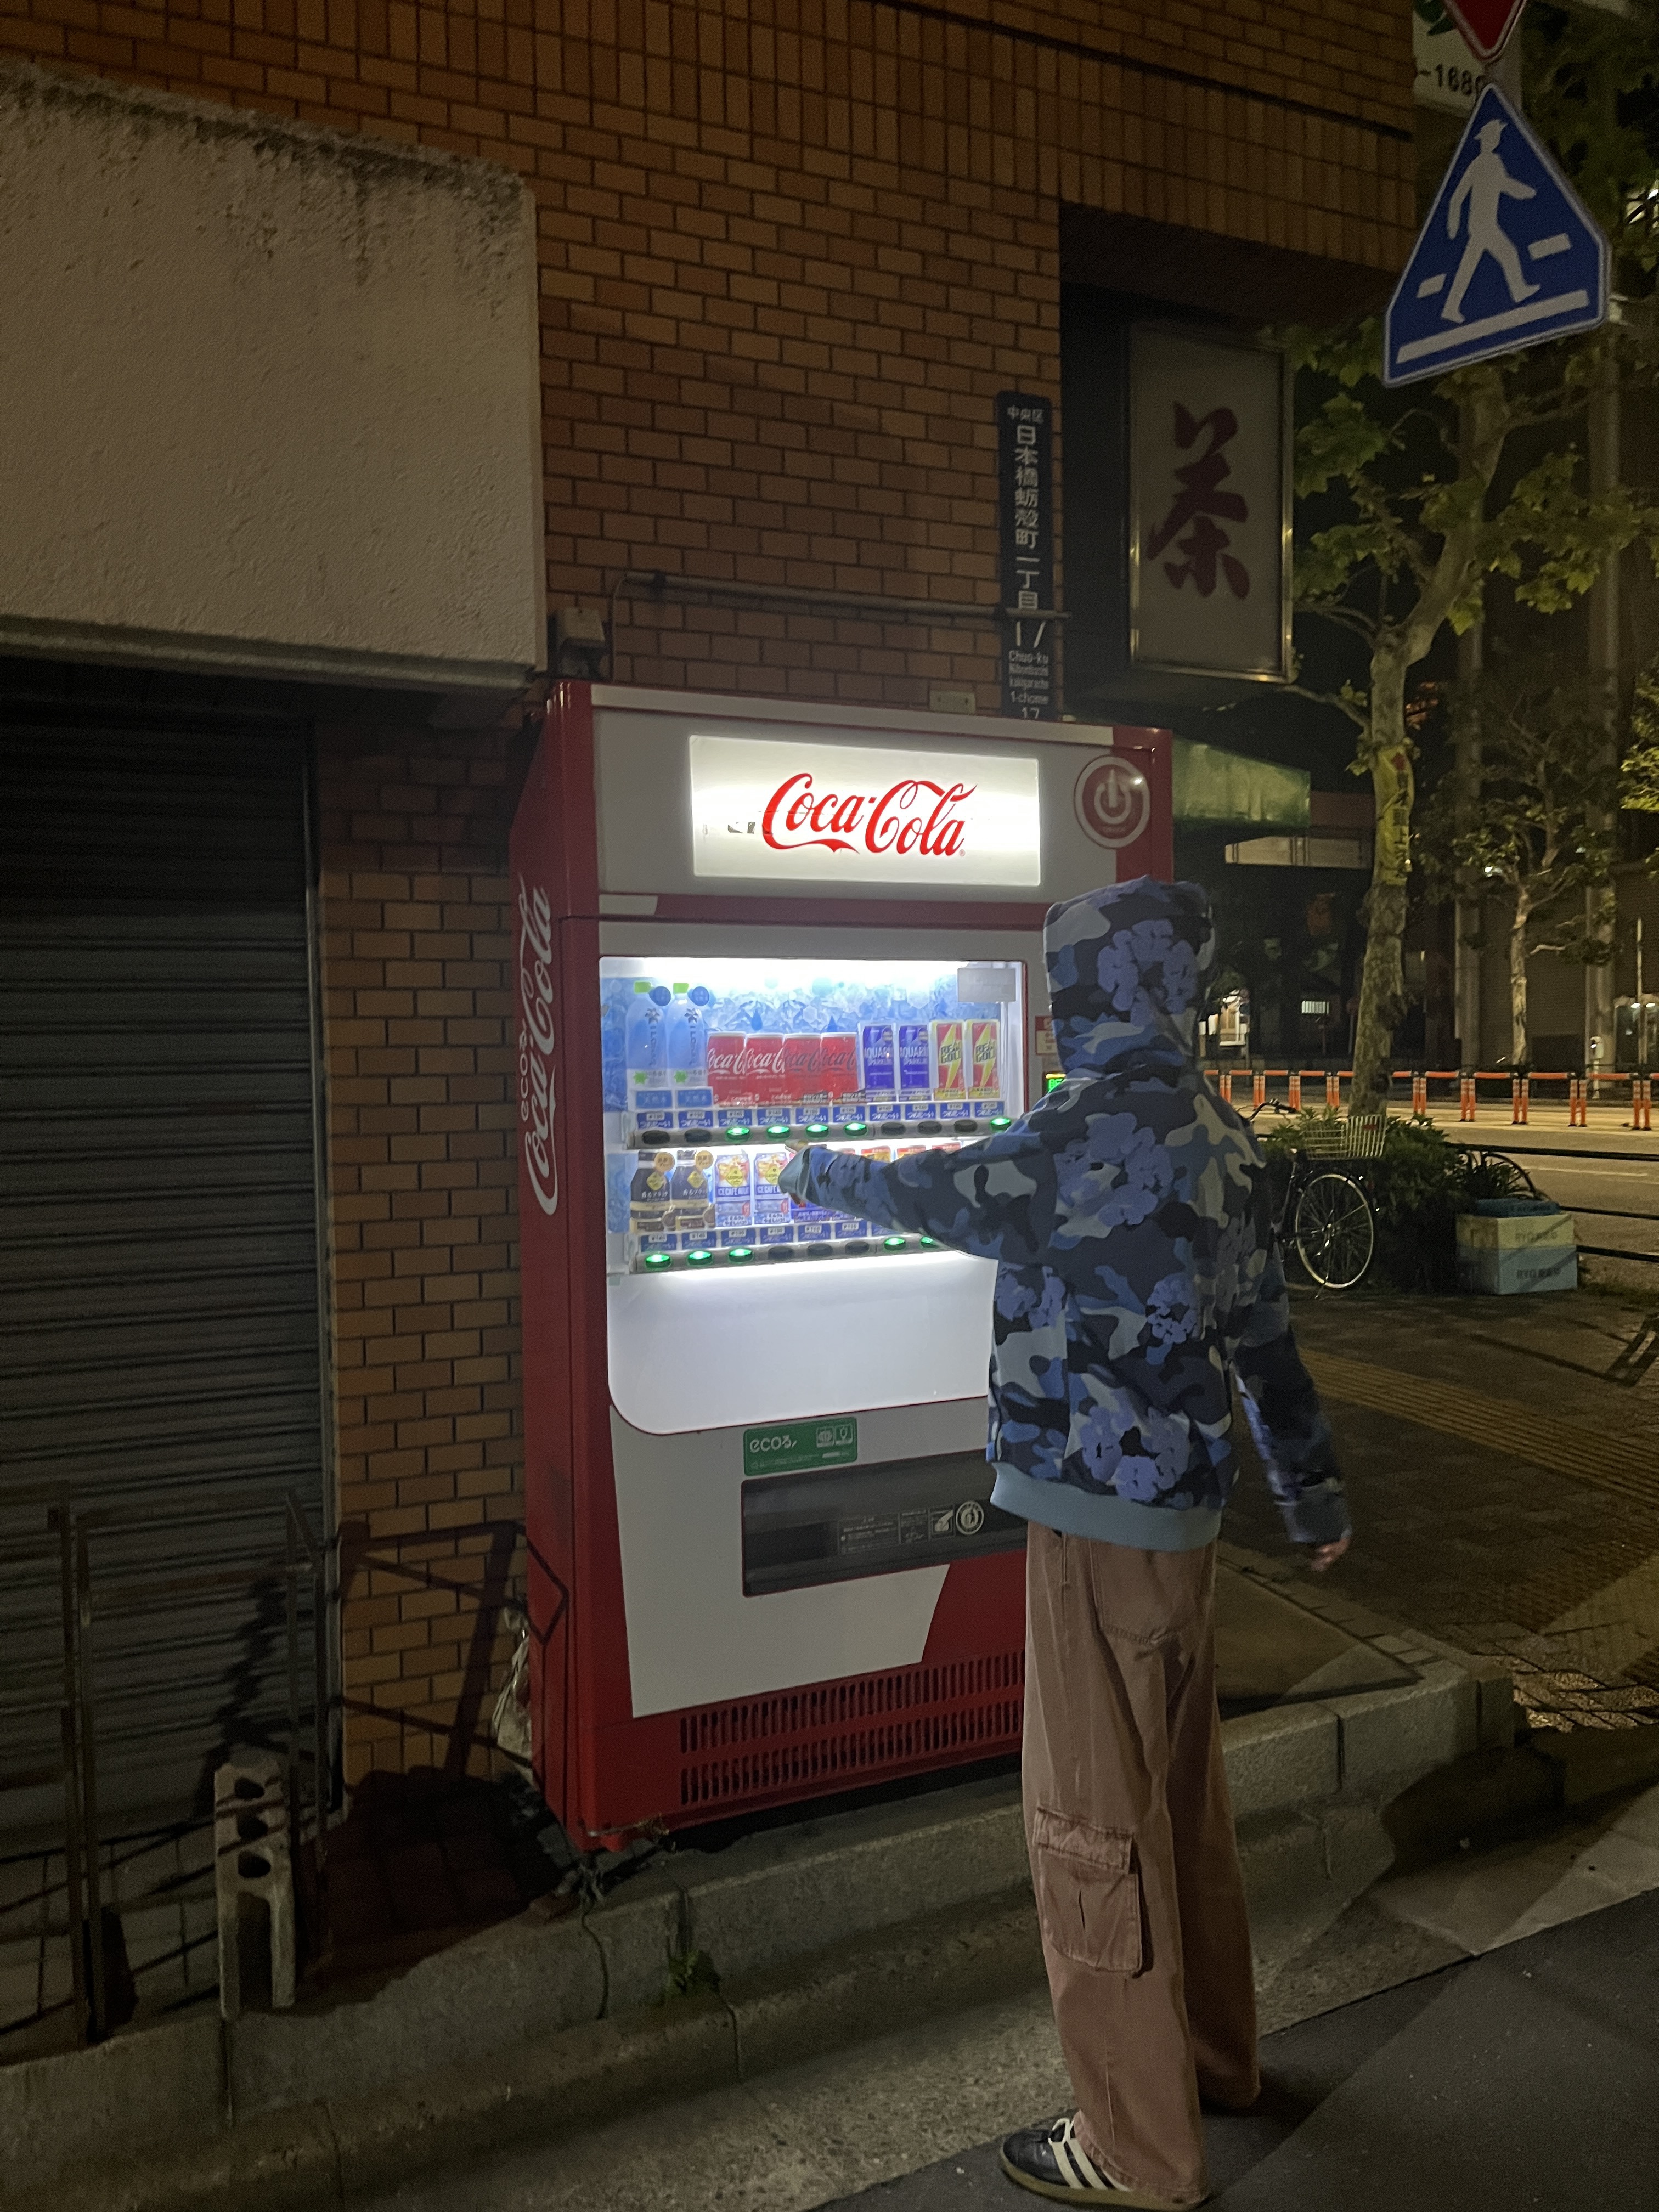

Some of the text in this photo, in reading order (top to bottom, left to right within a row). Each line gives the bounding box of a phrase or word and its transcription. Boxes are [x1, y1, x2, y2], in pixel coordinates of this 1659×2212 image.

[1007, 405, 1045, 423] 中央区
[1021, 707, 1040, 719] 17
[761, 772, 977, 856] Coca-Cola
[518, 872, 558, 1215] Coca-Cola
